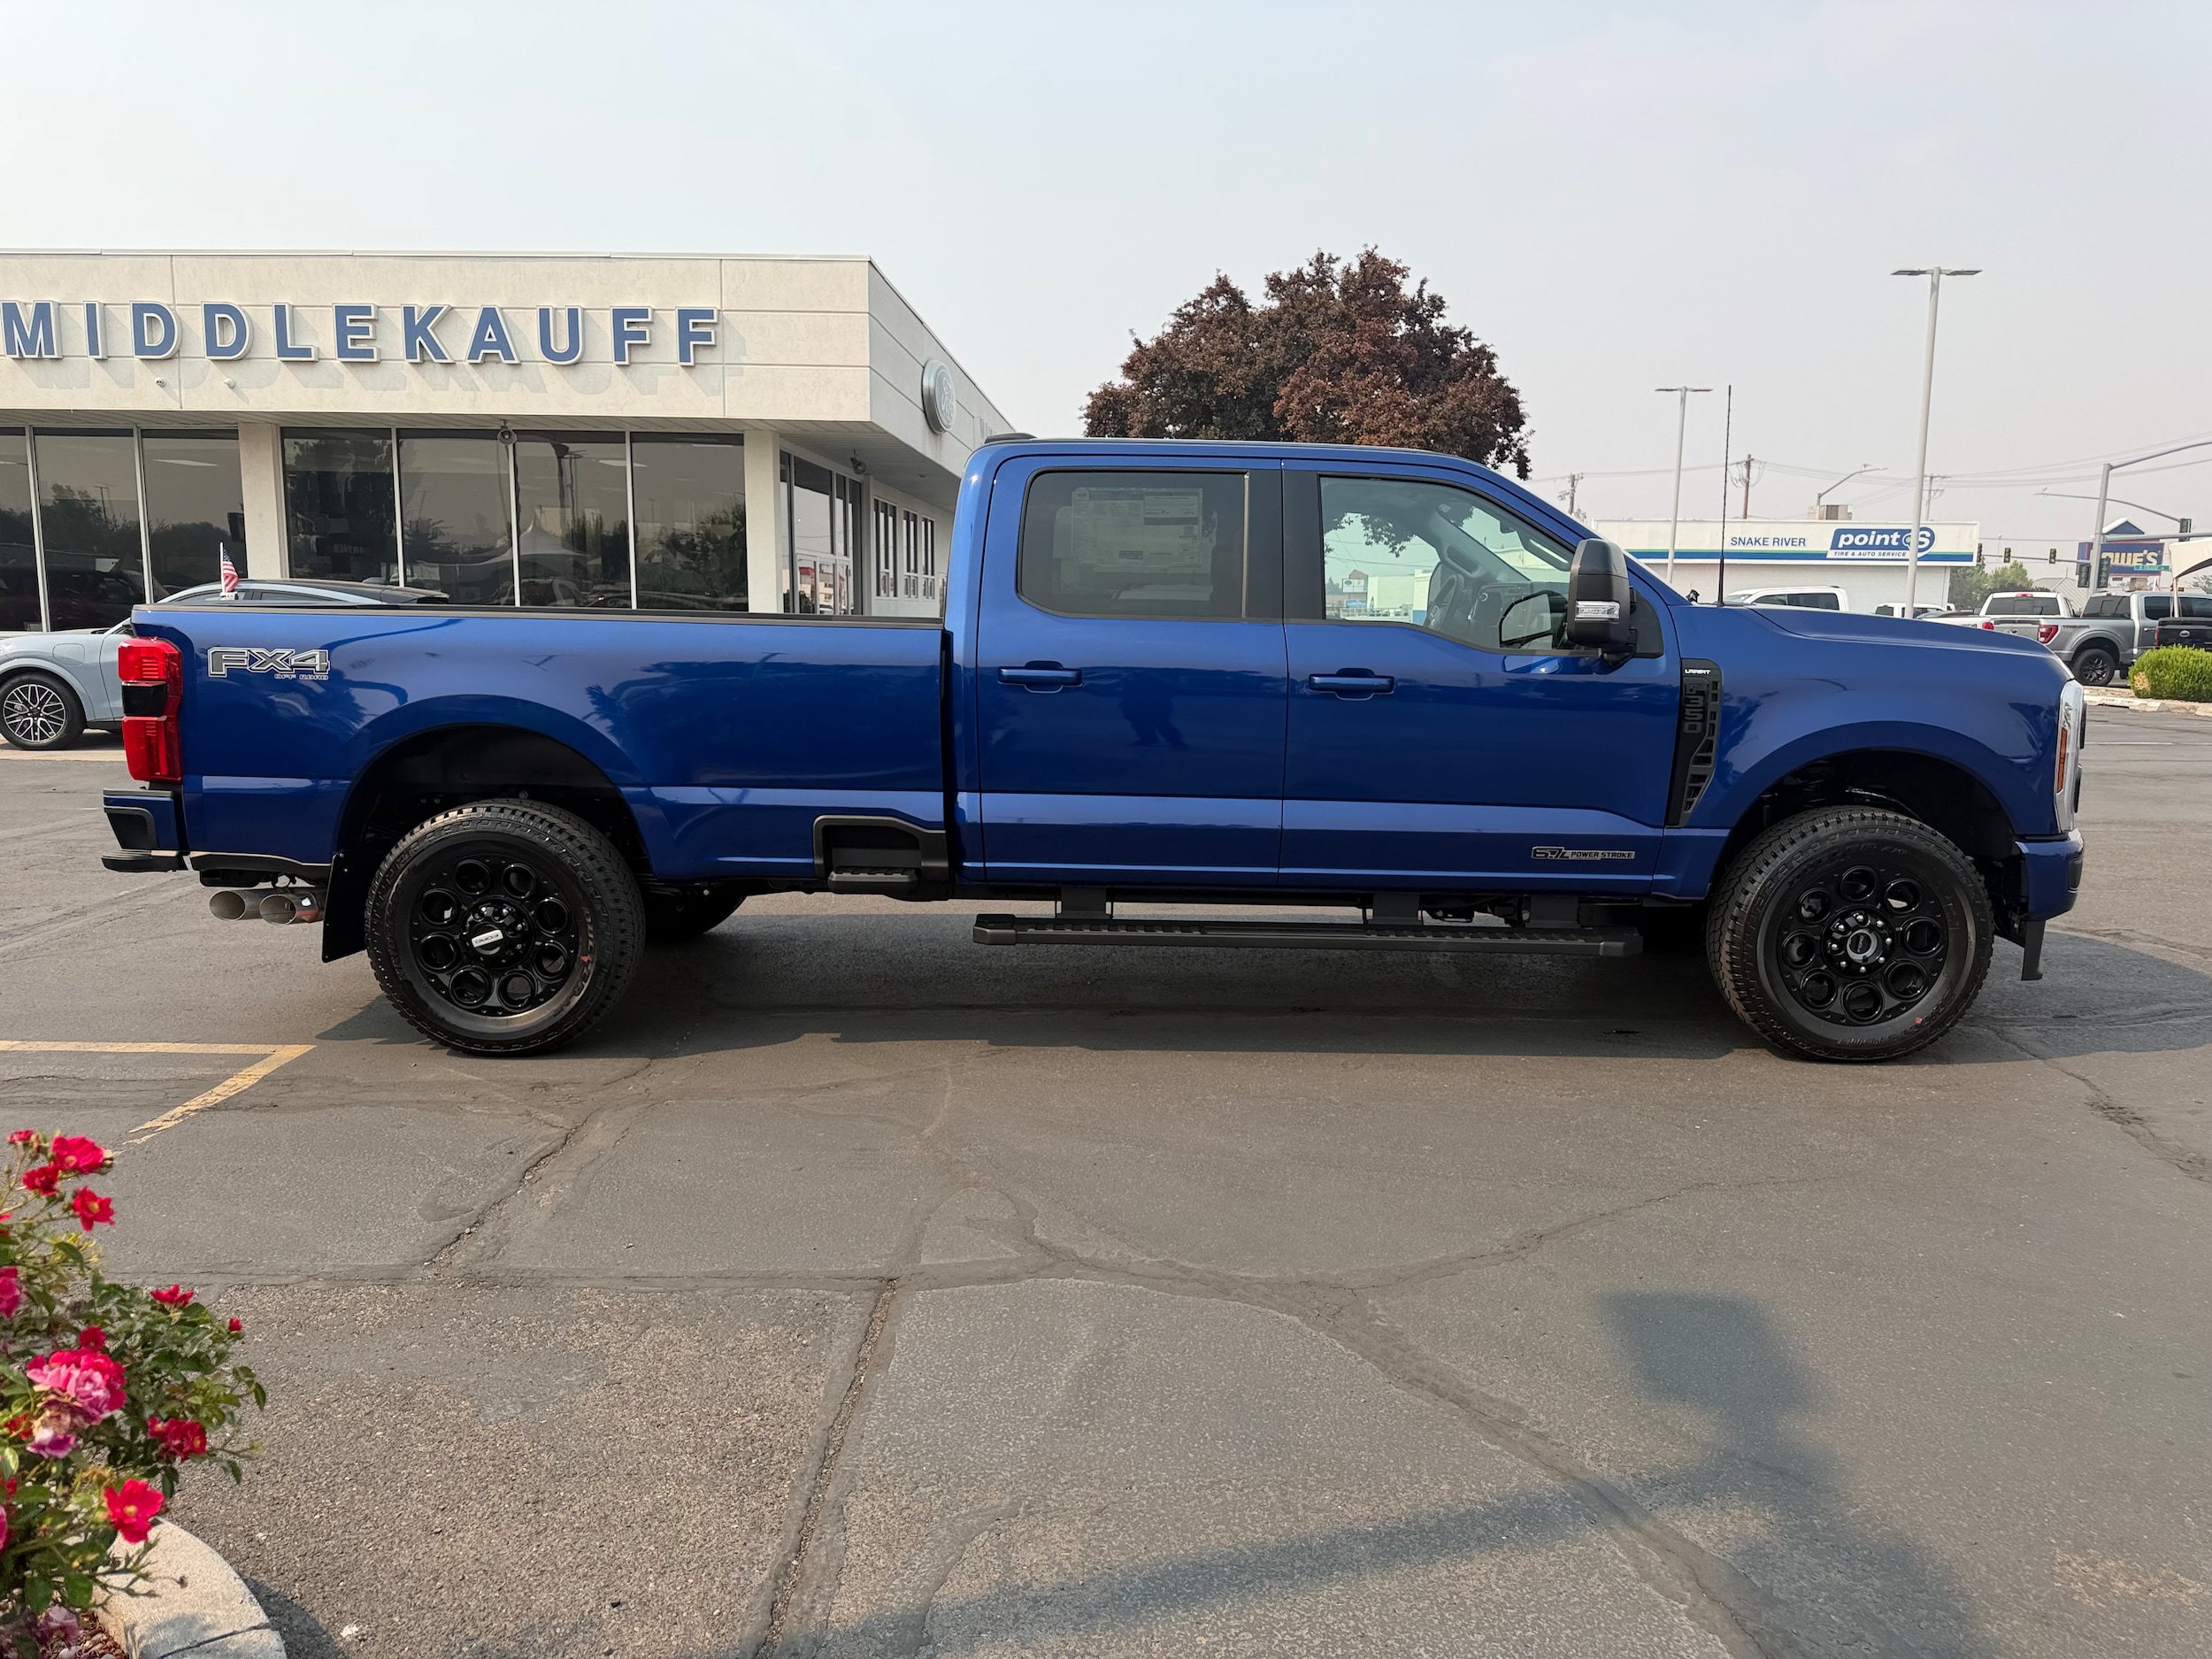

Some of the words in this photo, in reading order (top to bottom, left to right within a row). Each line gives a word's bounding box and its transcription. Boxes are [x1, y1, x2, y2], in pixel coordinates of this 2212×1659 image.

[0, 300, 718, 366] MIDDLEKAUFF
[1731, 536, 1770, 546] SNAKE
[1772, 537, 1806, 547] RIVER
[1838, 531, 1900, 549] point
[2101, 549, 2158, 566] OWE'S
[208, 646, 331, 678] FX4
